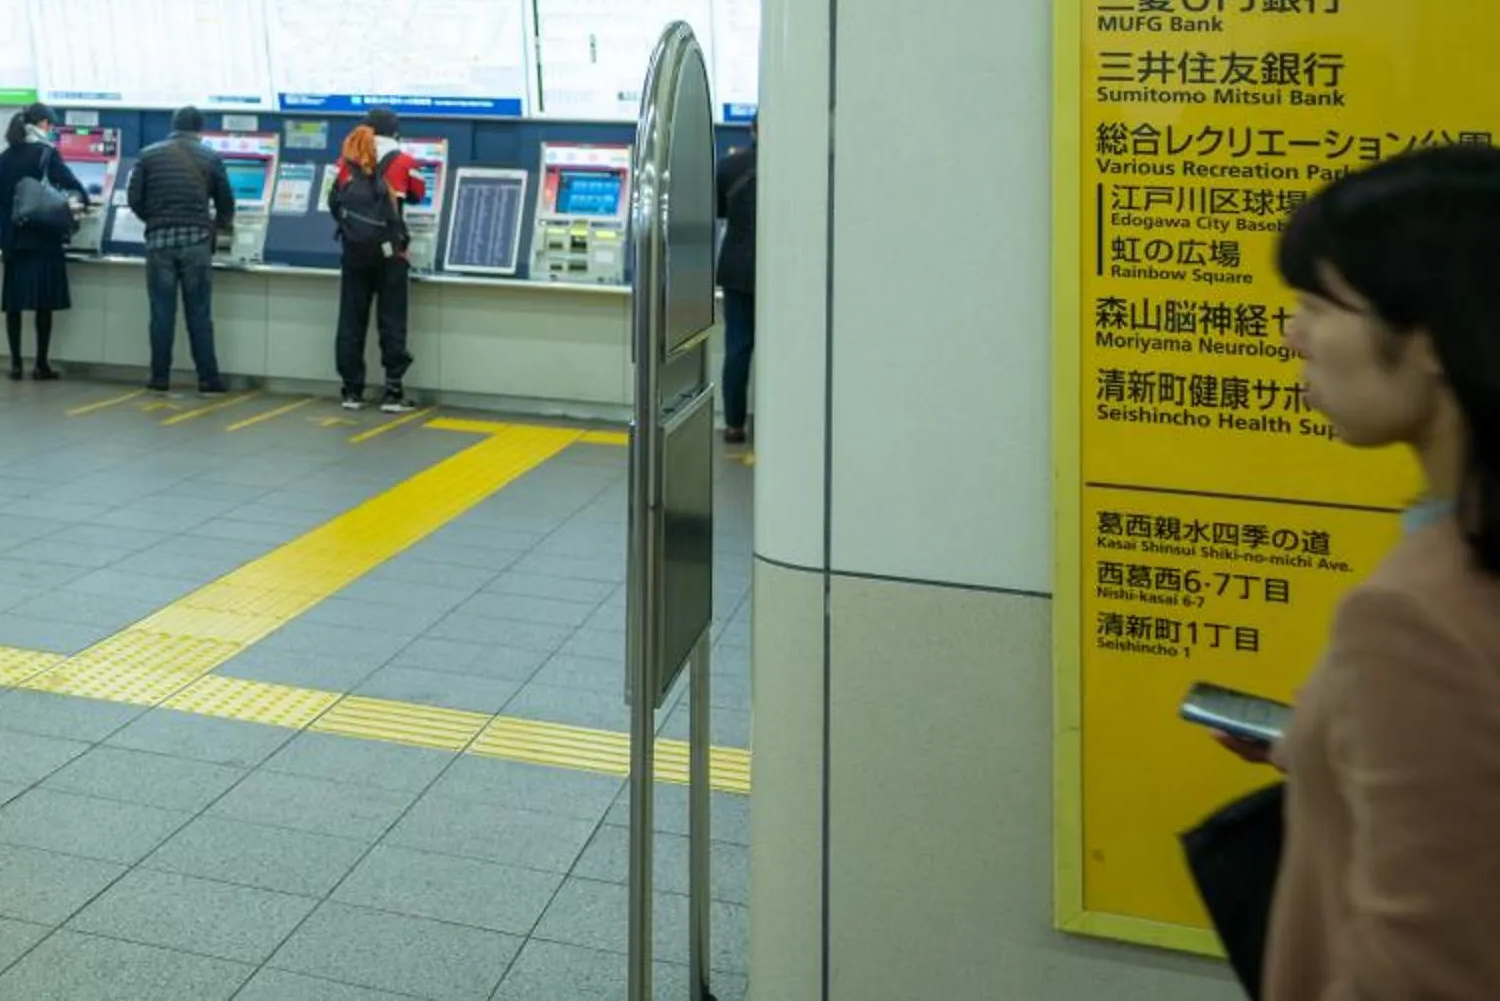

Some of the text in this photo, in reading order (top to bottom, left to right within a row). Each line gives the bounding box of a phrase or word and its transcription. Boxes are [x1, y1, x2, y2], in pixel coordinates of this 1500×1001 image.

[1098, 15, 1223, 33] MUFG Bank
[1097, 51, 1345, 87] 三井住友銀行
[1097, 86, 1345, 107] Sumitomo Mitsui Bank
[1096, 159, 1175, 177] Various
[1183, 161, 1298, 181] Recreation
[1111, 213, 1190, 231] Edogawa
[1197, 216, 1229, 234] City
[1111, 236, 1240, 268] 虹の広場
[1111, 264, 1253, 286] Rainbow Square
[1095, 332, 1192, 353] Moriyama
[1097, 404, 1211, 427] Seishincho
[1218, 413, 1291, 434] Health
[1097, 510, 1331, 556] 葛西親水四季の道
[1096, 537, 1353, 573] Kasai Shinsui Shiki-no-michi Ave.
[1183, 596, 1205, 608] 6-7
[1097, 611, 1260, 653] 清新町1丁目
[1096, 638, 1190, 658] Seishincho 1
